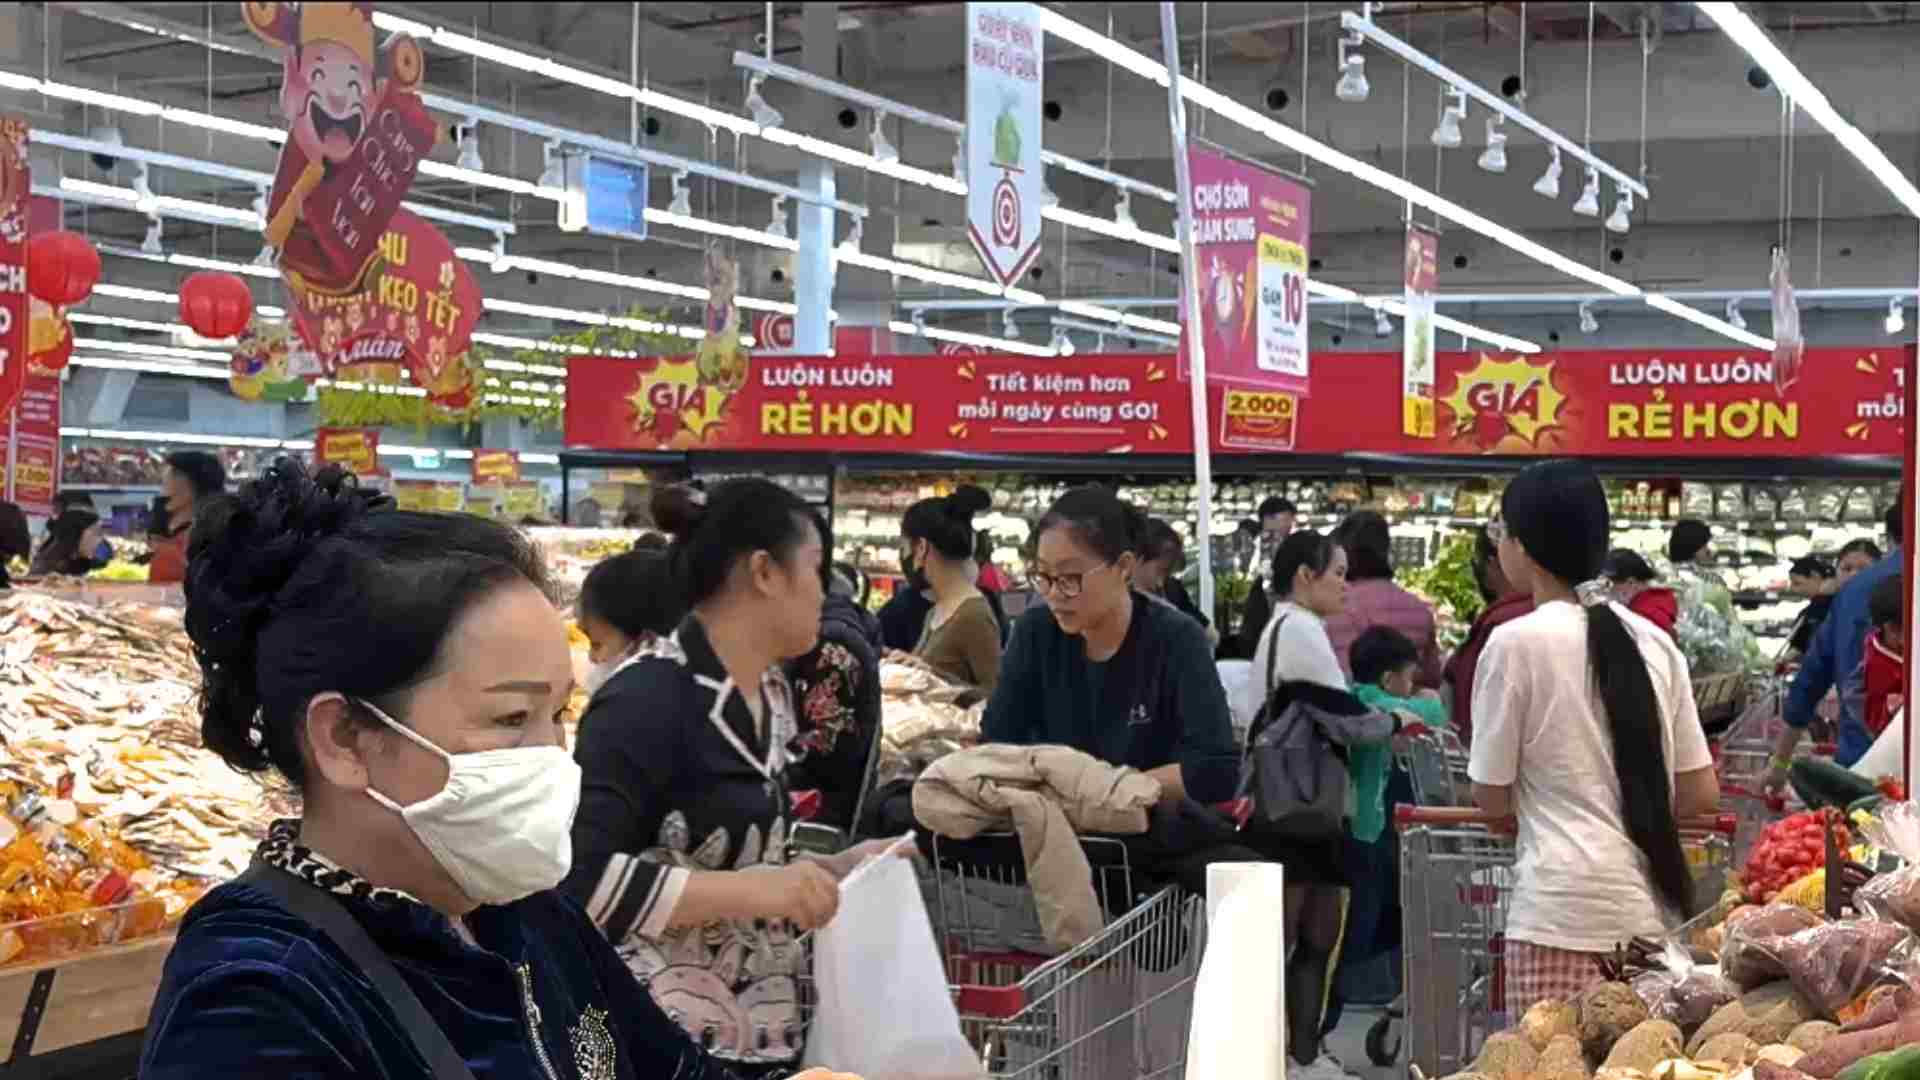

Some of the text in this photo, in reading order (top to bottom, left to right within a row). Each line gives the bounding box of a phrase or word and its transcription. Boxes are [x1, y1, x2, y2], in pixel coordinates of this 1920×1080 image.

[1283, 271, 1302, 326] 10
[763, 362, 893, 386] LUÔN LUÔN
[986, 371, 1131, 396] Tiết kiệm hơn
[1610, 356, 1773, 384] LUÔN LUÔN
[761, 389, 914, 436] RẺ HƠN
[1119, 402, 1159, 420] GO!
[1229, 394, 1291, 414] 2.000
[1466, 378, 1544, 422] GIÁ
[1608, 386, 1798, 439] RẺ HƠN
